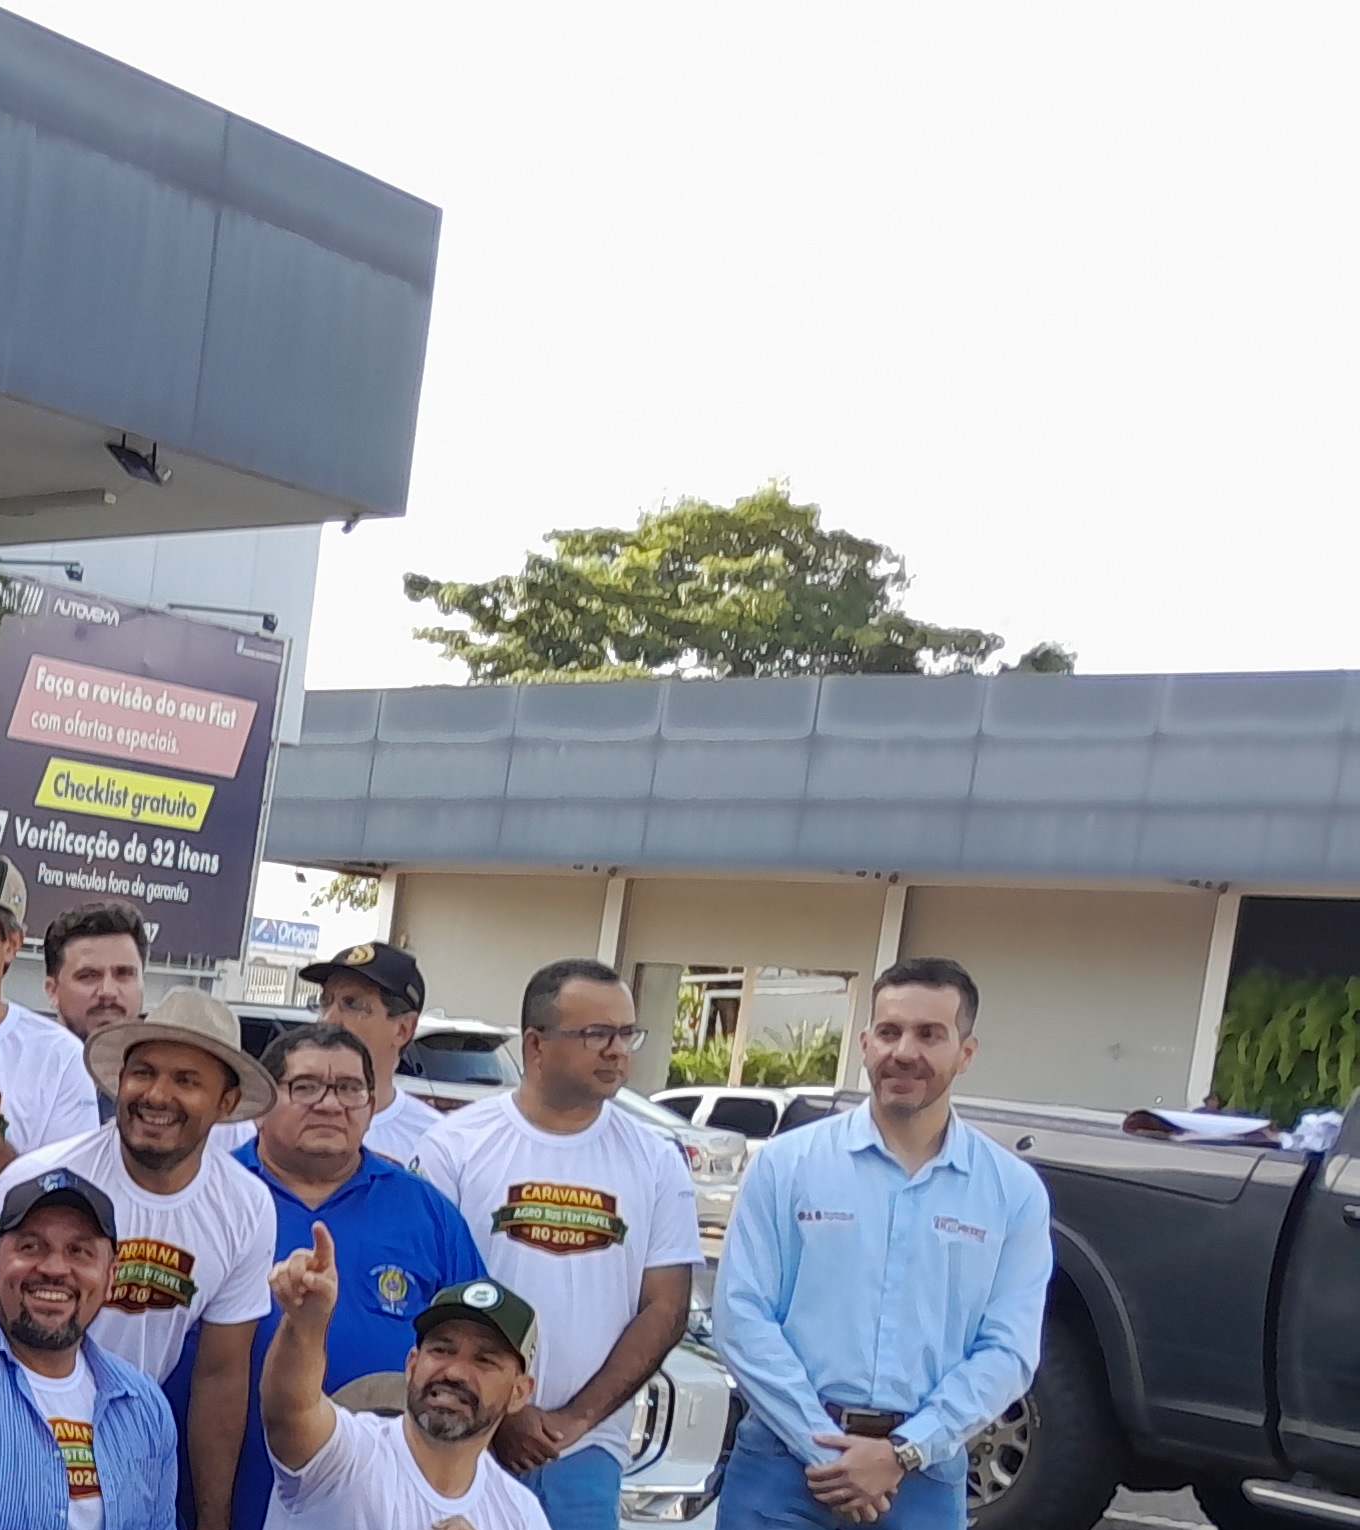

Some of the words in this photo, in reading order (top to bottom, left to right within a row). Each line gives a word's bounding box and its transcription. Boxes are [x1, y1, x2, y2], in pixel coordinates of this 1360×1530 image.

[36, 665, 75, 701] Faça
[78, 681, 90, 700] a
[93, 682, 152, 713] revisão
[179, 701, 206, 723] seu
[209, 701, 238, 729] Fiat
[31, 710, 61, 732] com
[64, 709, 114, 742] ofertas
[117, 726, 181, 755] especiais.
[53, 771, 129, 809] Checklist
[132, 790, 197, 819] gratuito
[14, 815, 120, 865] Verificação
[124, 831, 147, 863] de
[151, 838, 176, 868] 32
[178, 840, 221, 875] itens
[37, 862, 63, 887] Para
[66, 867, 107, 893] veículos
[109, 870, 130, 894] fora
[147, 881, 190, 904] garantia
[513, 1207, 543, 1220] AGRO
[520, 1184, 604, 1209] CARAVANA
[531, 1226, 551, 1242] RO
[551, 1230, 586, 1246] 2026
